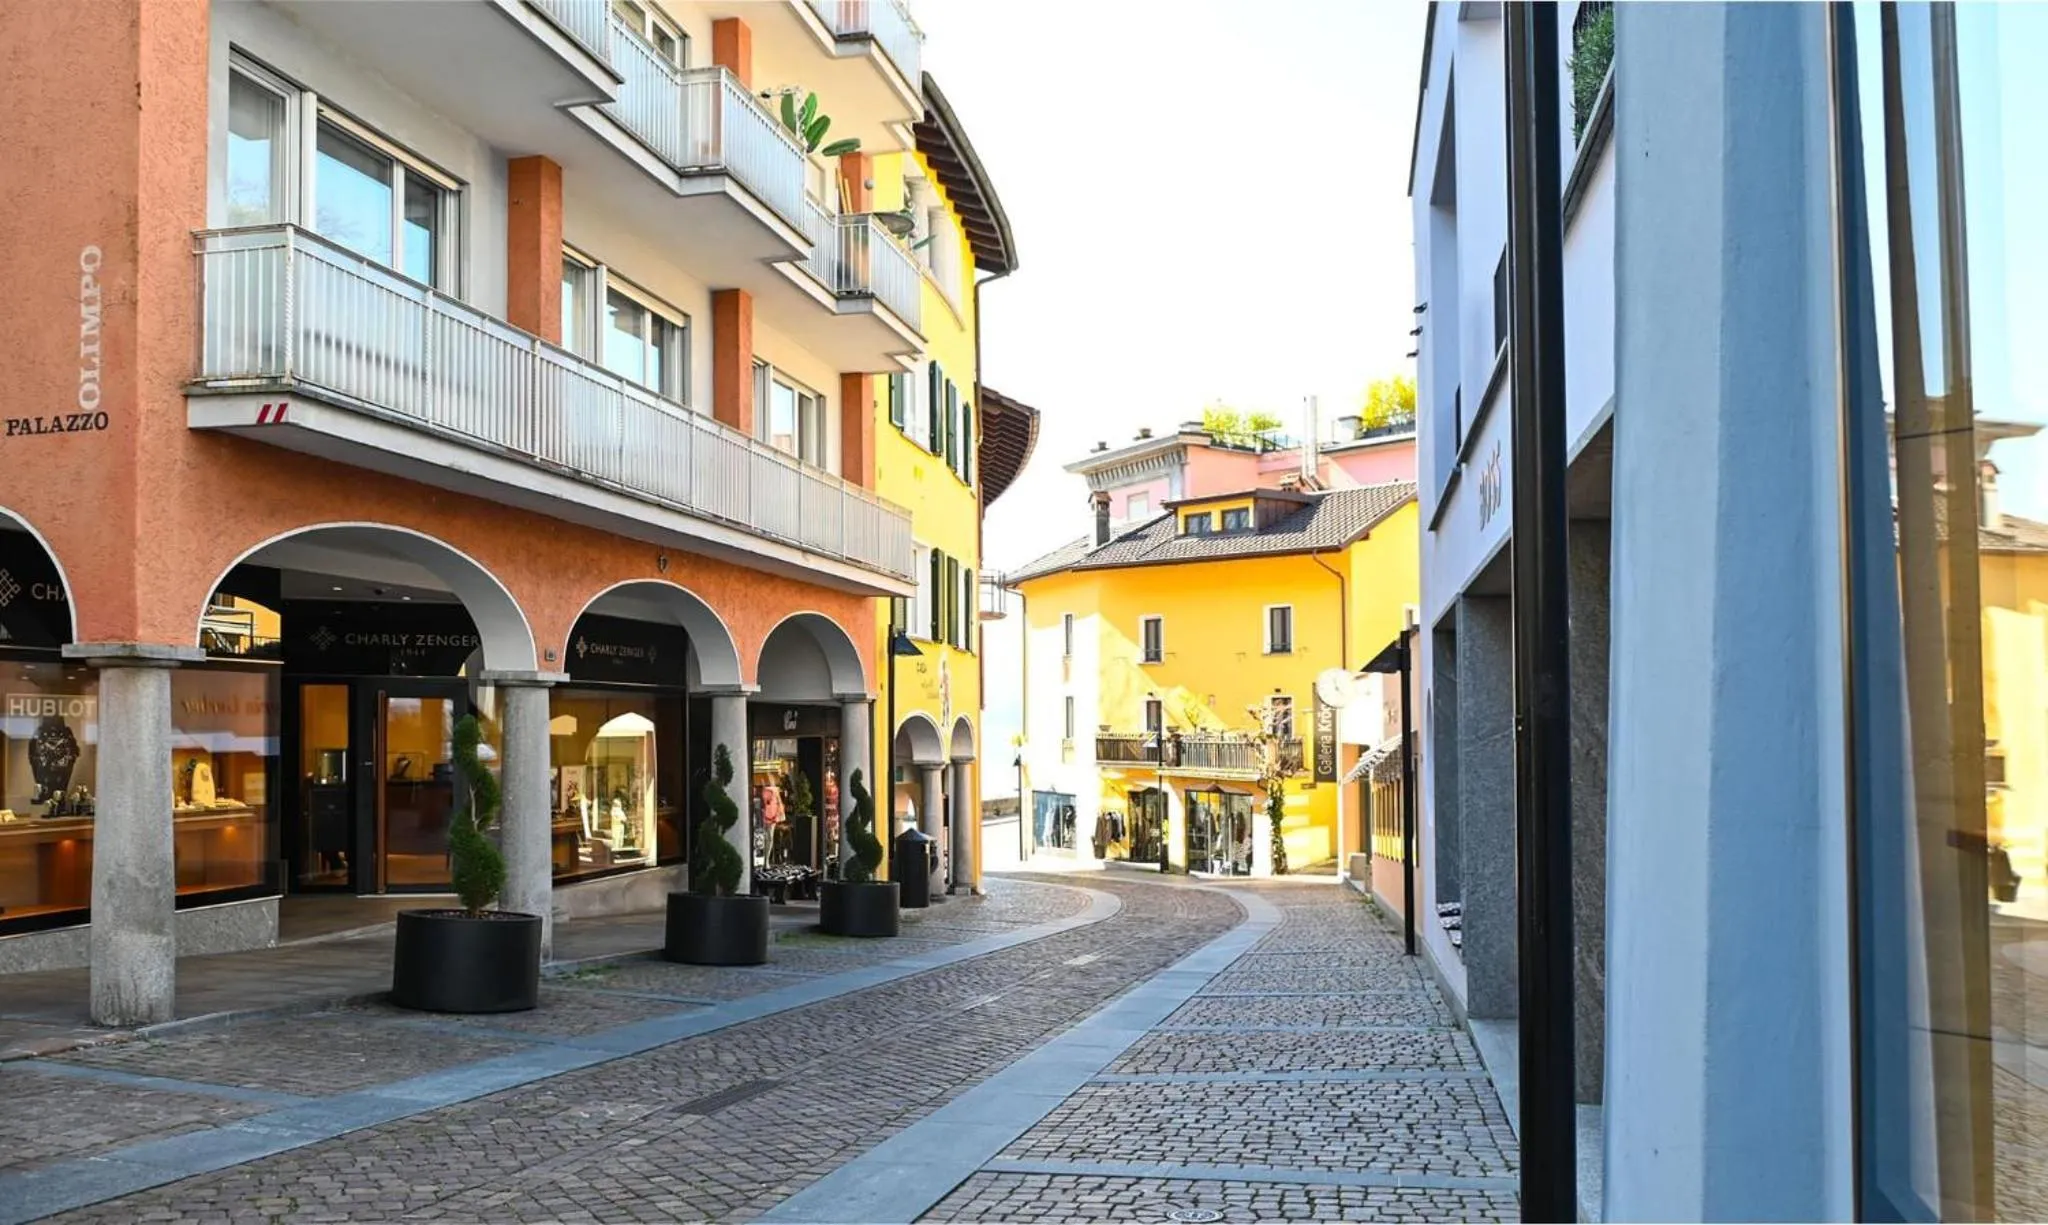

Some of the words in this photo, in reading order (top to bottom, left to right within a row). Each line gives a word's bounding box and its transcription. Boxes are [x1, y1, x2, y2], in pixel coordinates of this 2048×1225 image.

[79, 245, 102, 410] OLIMPO
[6, 411, 109, 437] PALAZZO
[344, 633, 410, 646] CHARLY
[415, 634, 480, 648] ZENGER
[9, 698, 96, 717] HUBLOT
[1317, 735, 1333, 776] Galleria
